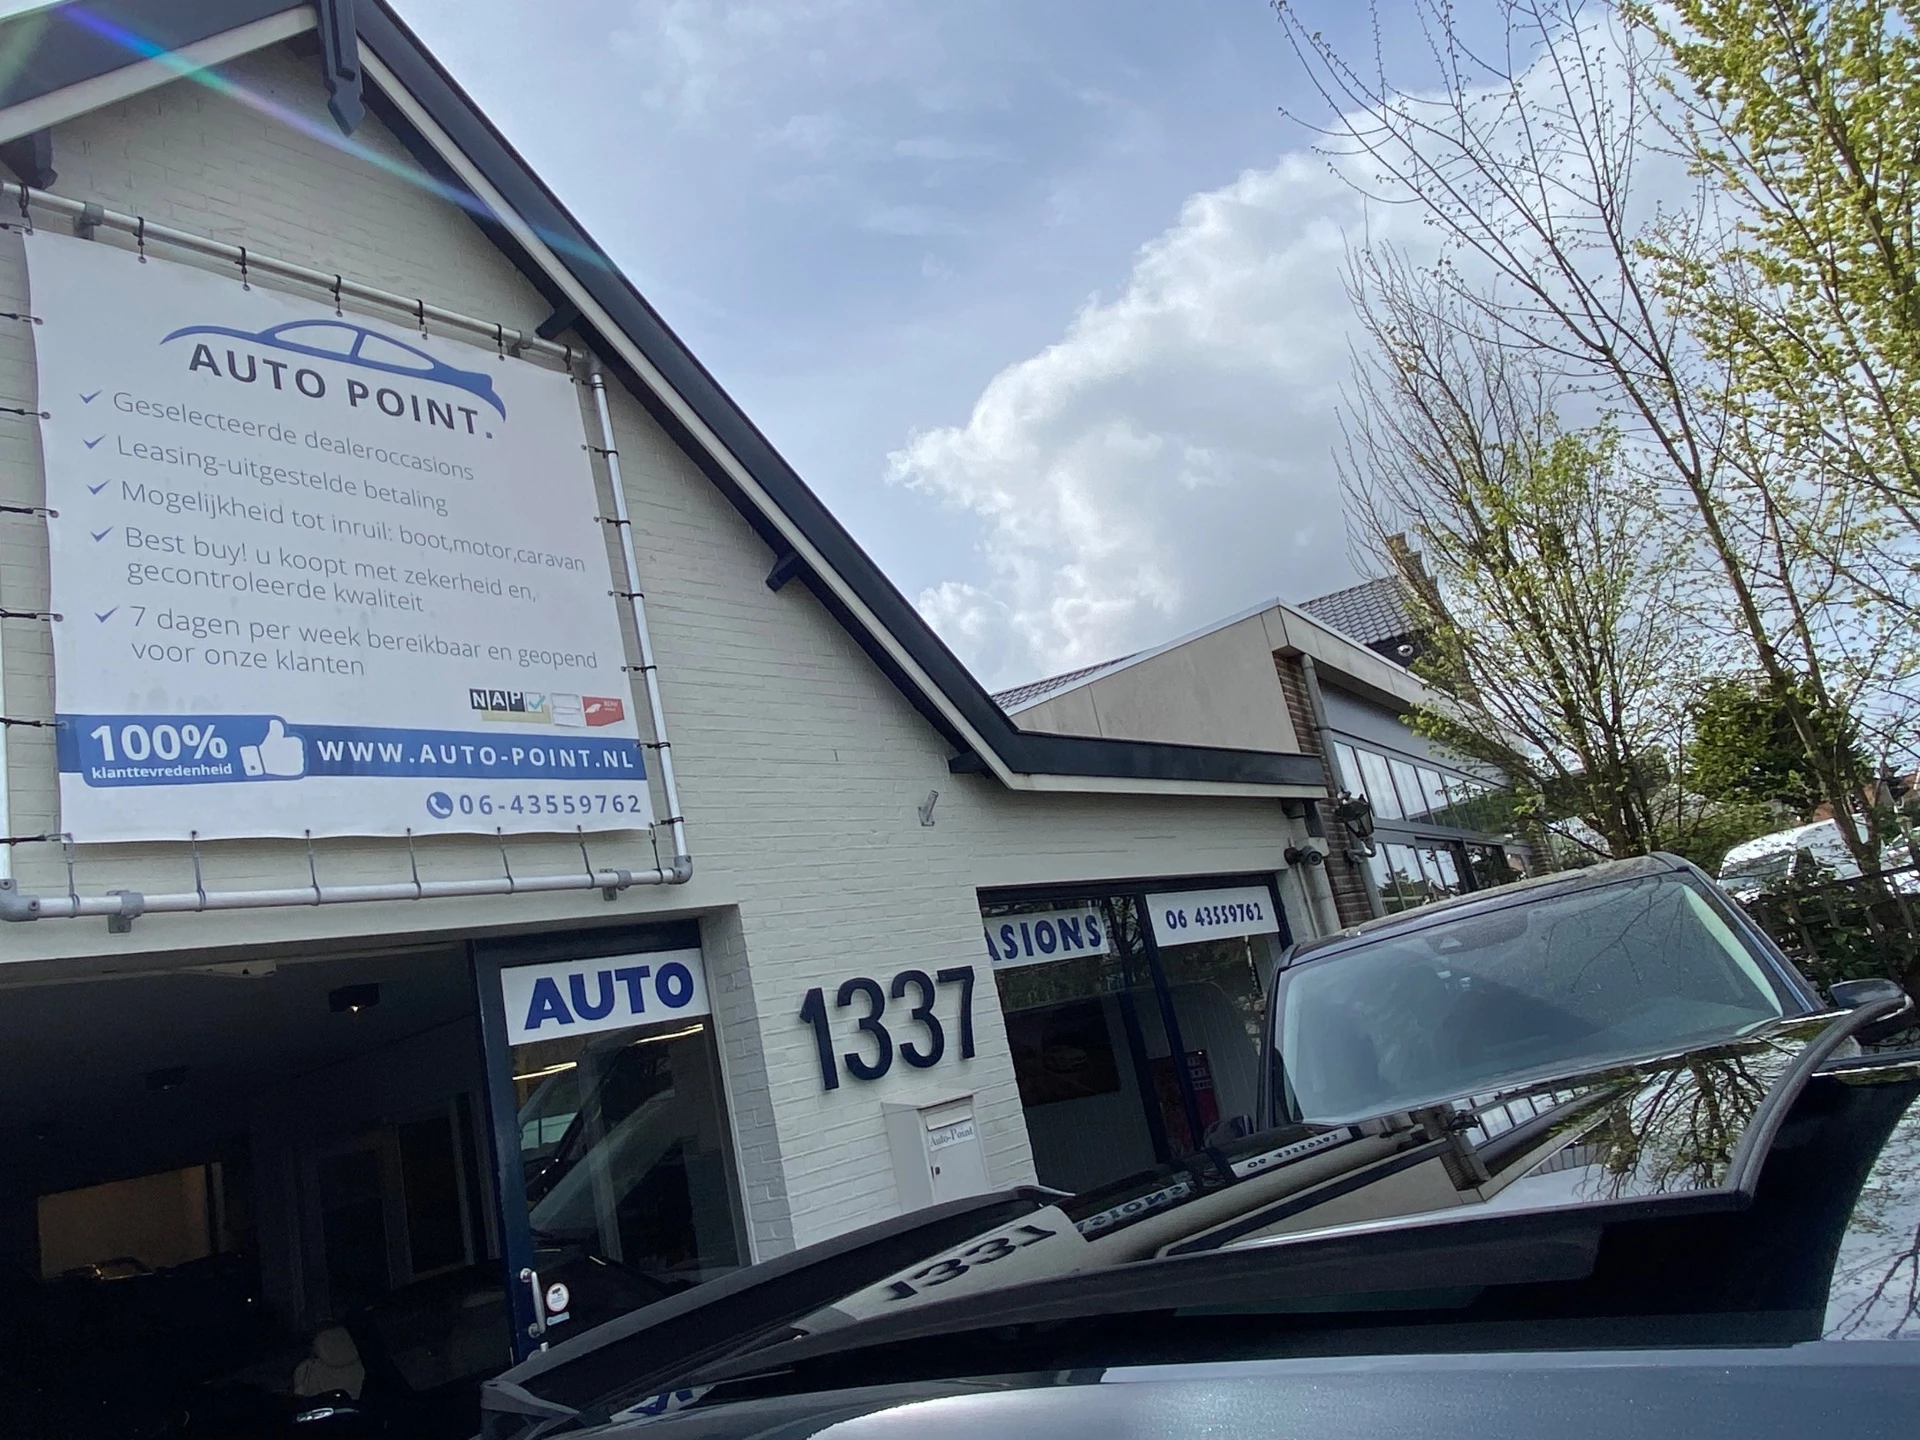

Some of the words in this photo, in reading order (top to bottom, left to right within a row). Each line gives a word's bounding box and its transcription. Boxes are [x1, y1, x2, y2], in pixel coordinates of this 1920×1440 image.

[188, 343, 327, 399] AUTO
[346, 378, 494, 439] POINT.
[113, 392, 298, 445] Geselecteerde
[304, 430, 475, 481] dealeroccasions
[117, 435, 358, 496] Leasing-uitgestelde
[364, 480, 449, 517] betaling
[121, 480, 285, 525] Mogelijkheid
[292, 509, 326, 532] tot
[332, 514, 394, 542] inruil:
[399, 524, 586, 573] boot,motor,caravan
[125, 526, 186, 554] Best
[193, 534, 248, 566] buy!
[256, 549, 271, 565] u
[279, 547, 348, 578] koopt
[355, 562, 398, 583] met
[404, 568, 503, 597] zekerheid
[508, 583, 537, 604] en,
[127, 562, 327, 601] gecontroleerde
[333, 582, 424, 613] kwaliteit
[130, 605, 146, 627] 7
[157, 608, 241, 639] dagen
[249, 621, 291, 644] per
[298, 624, 362, 648] week
[367, 628, 481, 659] bereikbaar
[487, 644, 513, 661] en
[517, 648, 599, 671] geopend
[131, 642, 196, 664] voor
[204, 648, 269, 670] onze
[276, 649, 366, 676] klanten
[472, 691, 522, 708] NAP
[90, 724, 228, 761] 100%
[316, 740, 634, 768] WWW.AUTO-POINT.NL
[92, 763, 233, 779] klanttevredenheid
[459, 794, 643, 816] 06-43559762
[1165, 909, 1188, 930] 06
[1194, 902, 1264, 927] 43559762
[524, 962, 694, 1031] AUTO
[799, 965, 976, 1091] 1337
[930, 1126, 974, 1147] Auto-Point
